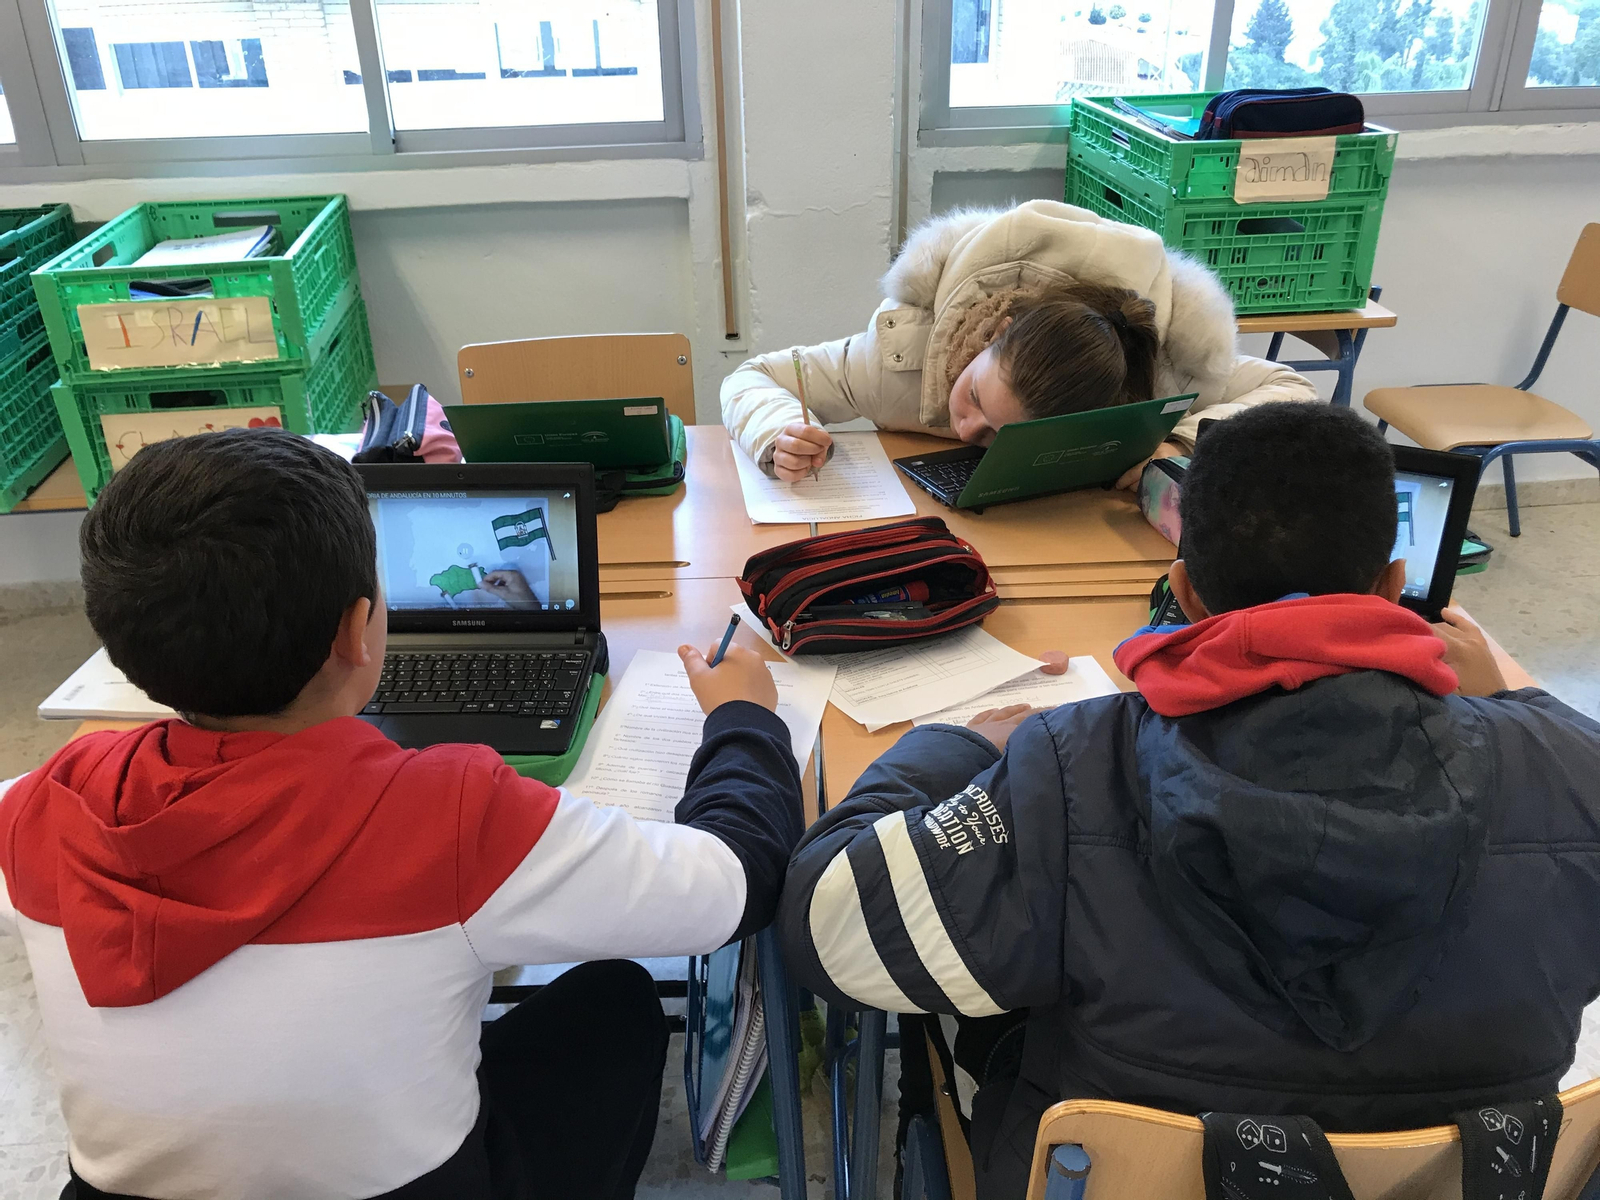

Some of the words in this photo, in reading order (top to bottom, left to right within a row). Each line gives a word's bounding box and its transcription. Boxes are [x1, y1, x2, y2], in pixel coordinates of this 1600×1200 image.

[103, 306, 275, 351] ISRAEL
[958, 804, 968, 814] to
[962, 812, 986, 845] Your
[933, 804, 974, 855] CATION
